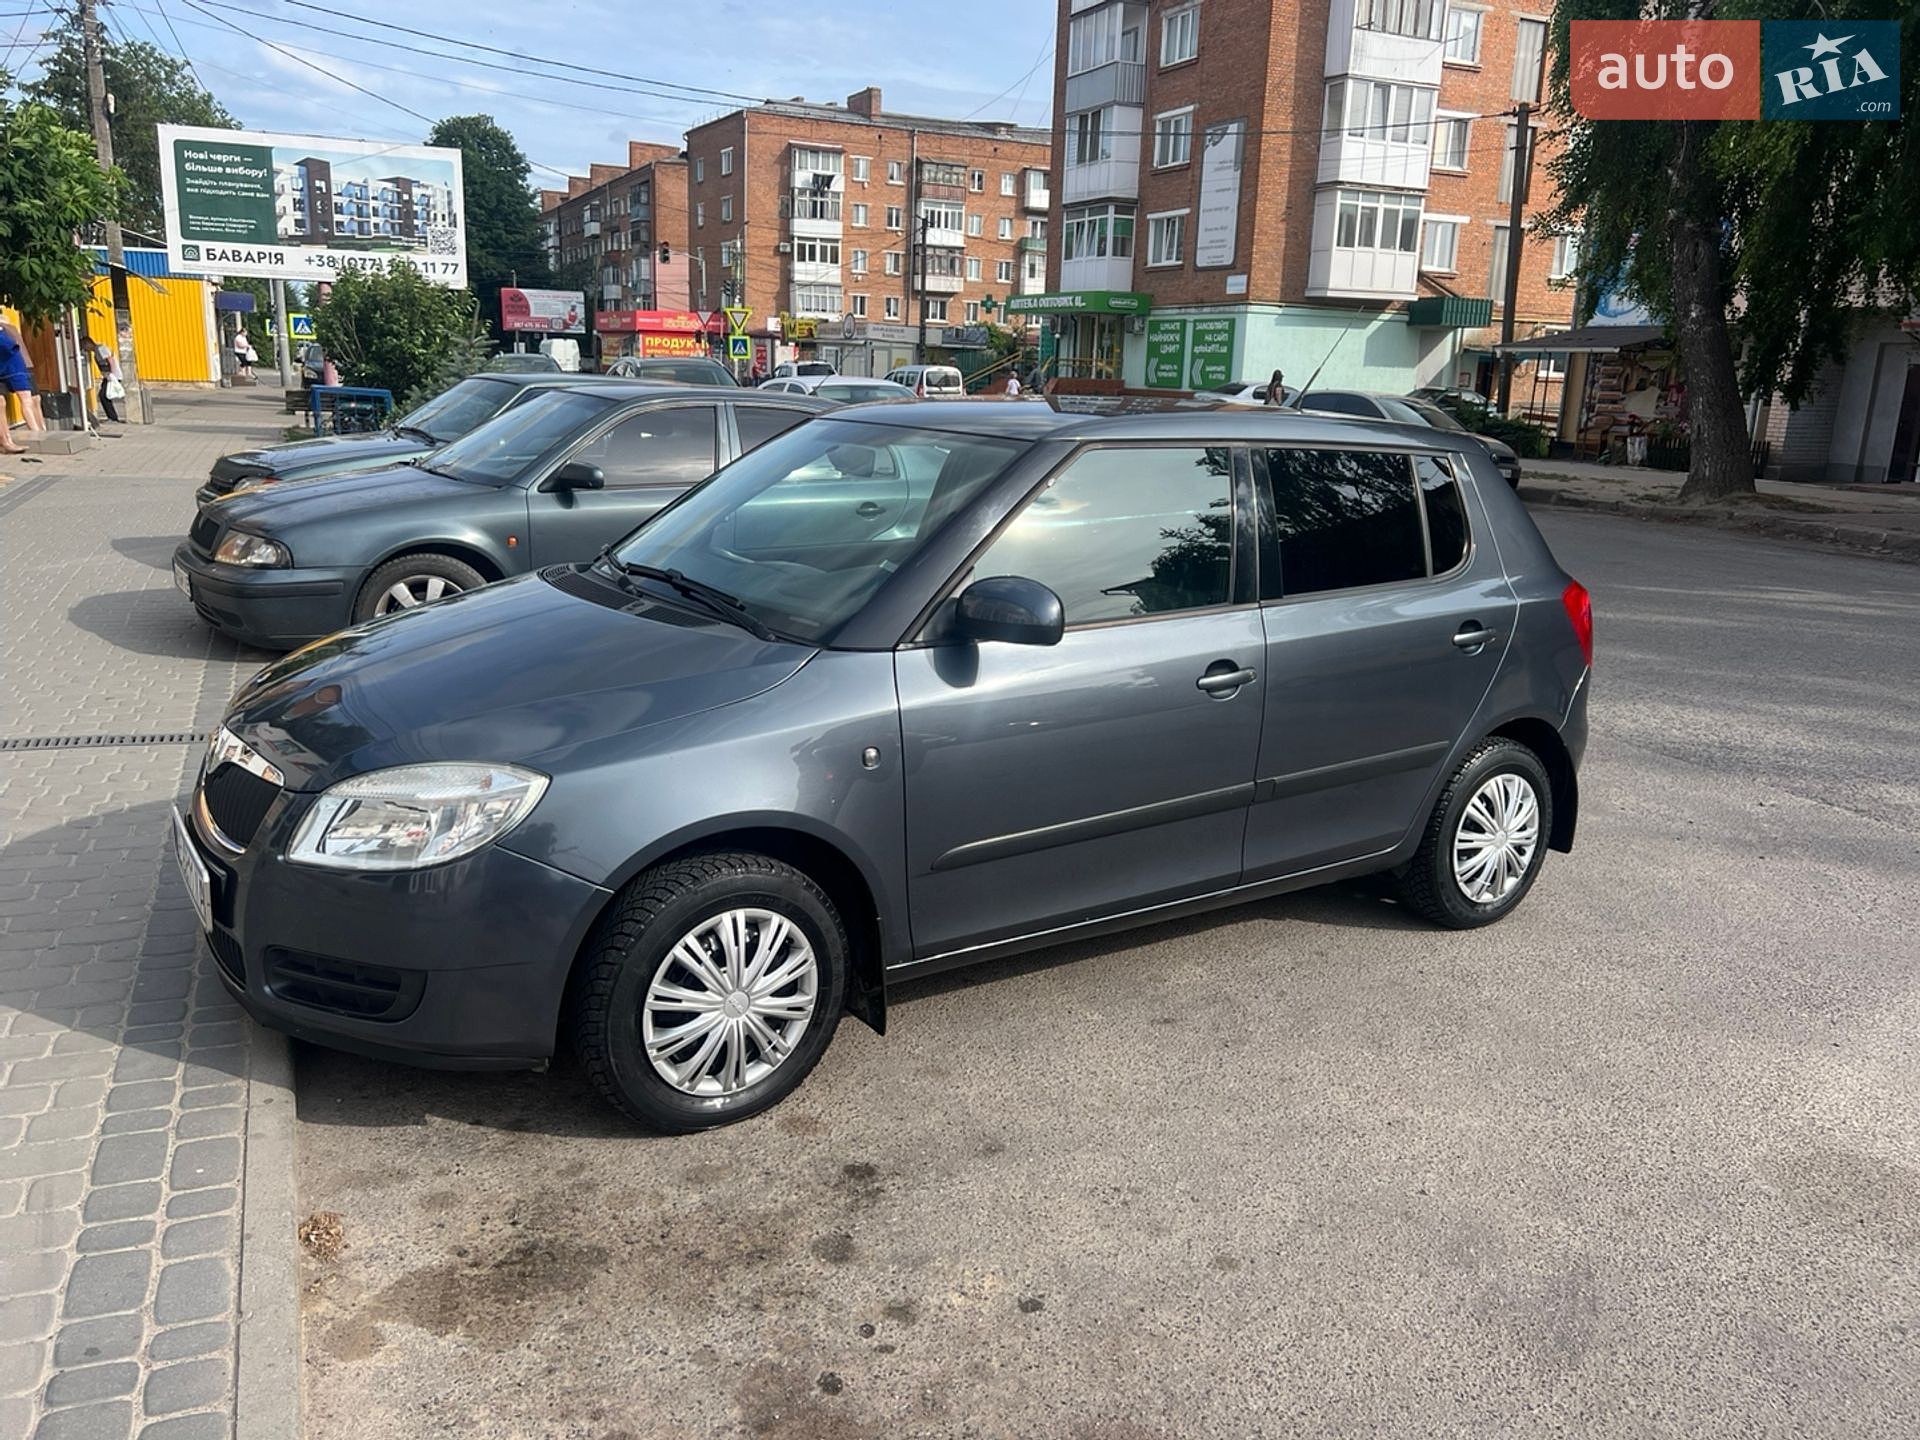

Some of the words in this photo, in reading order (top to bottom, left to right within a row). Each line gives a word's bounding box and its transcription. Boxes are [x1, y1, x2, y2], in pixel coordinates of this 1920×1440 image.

[183, 150, 209, 161] Нові
[209, 153, 241, 163] черги
[184, 162, 224, 174] більше
[224, 166, 268, 178] вибору!
[205, 247, 285, 265] БАВАРІЯ
[304, 254, 337, 268] +38
[421, 261, 437, 274] 11
[440, 262, 460, 275] 77
